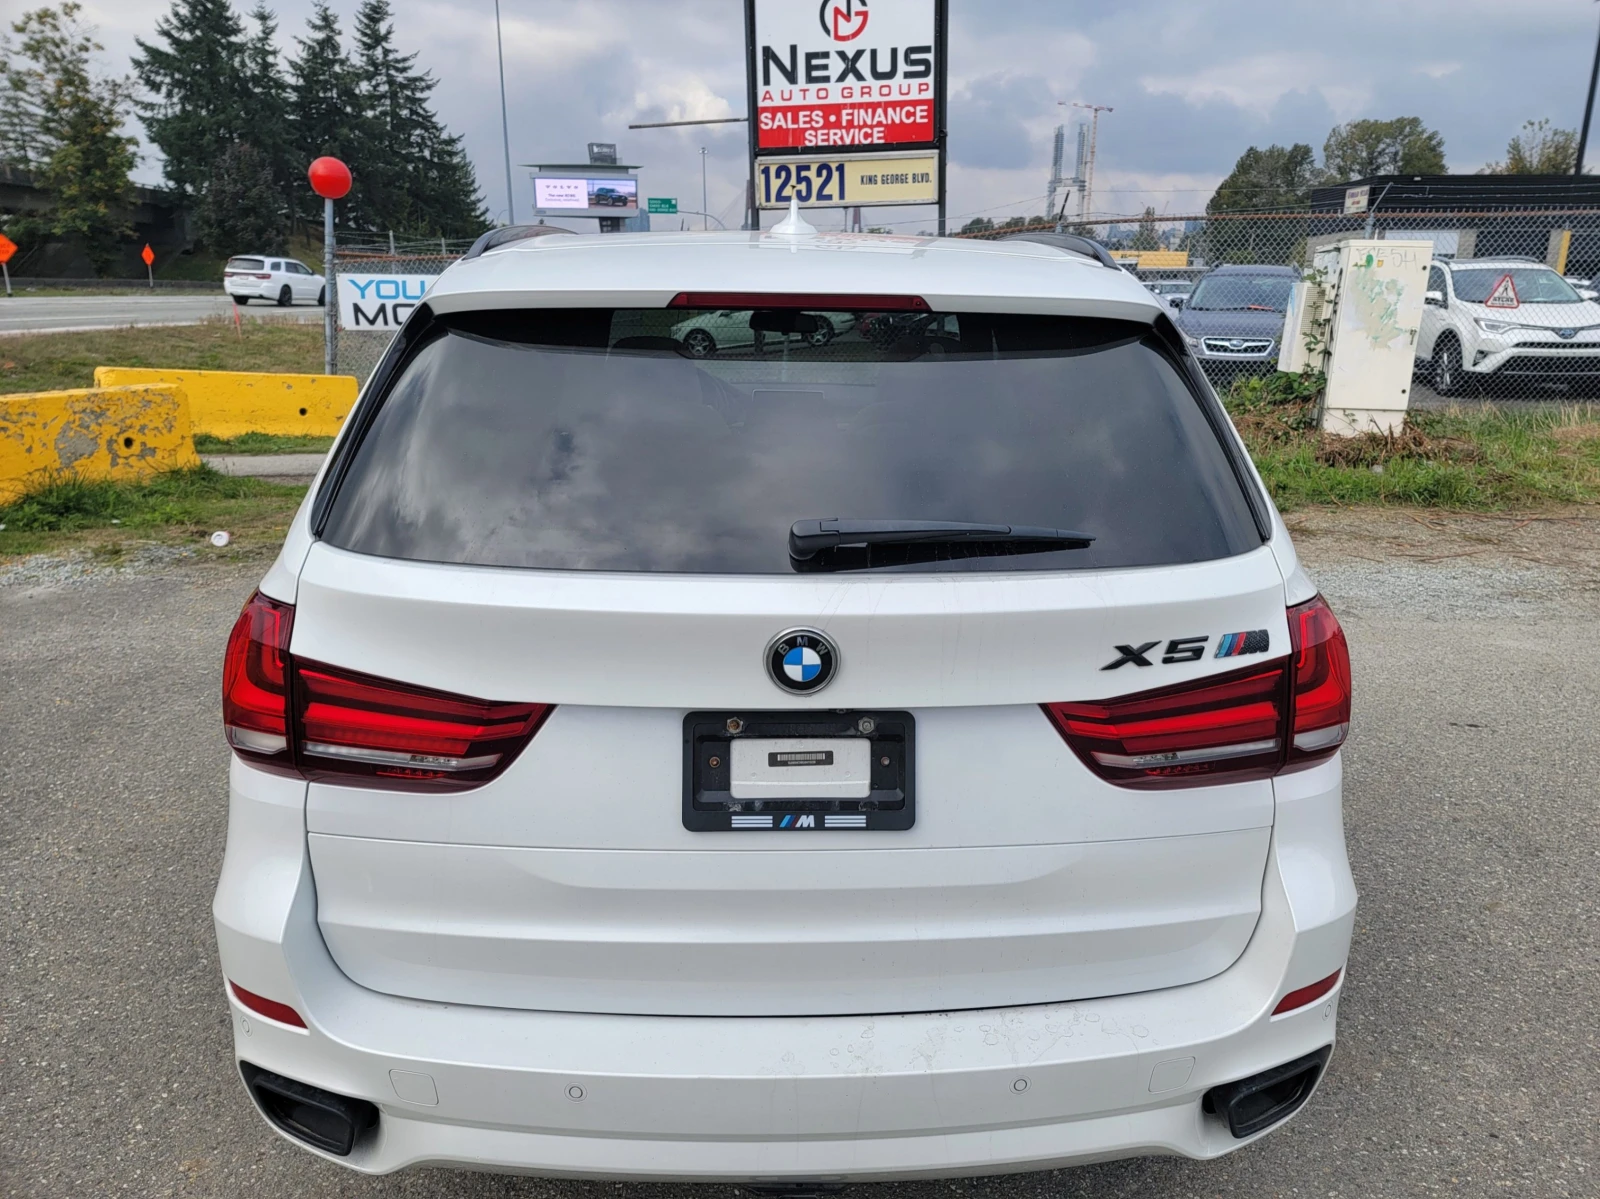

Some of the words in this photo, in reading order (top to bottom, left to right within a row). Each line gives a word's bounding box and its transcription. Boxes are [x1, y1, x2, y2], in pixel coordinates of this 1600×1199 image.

[762, 44, 933, 86] NEXUS
[761, 87, 829, 102] AUTO
[841, 83, 930, 99] GROUP
[760, 110, 824, 130] SALES
[841, 105, 928, 126] FINANCE
[804, 127, 885, 146] SERVICE
[760, 163, 846, 203] 12521
[860, 174, 878, 186] KING
[881, 173, 909, 185] GEORGE
[912, 172, 932, 184] BLVD.
[347, 279, 426, 300] YOU
[777, 636, 828, 656] BMW
[1099, 635, 1210, 671] X5
[795, 814, 815, 828] M
